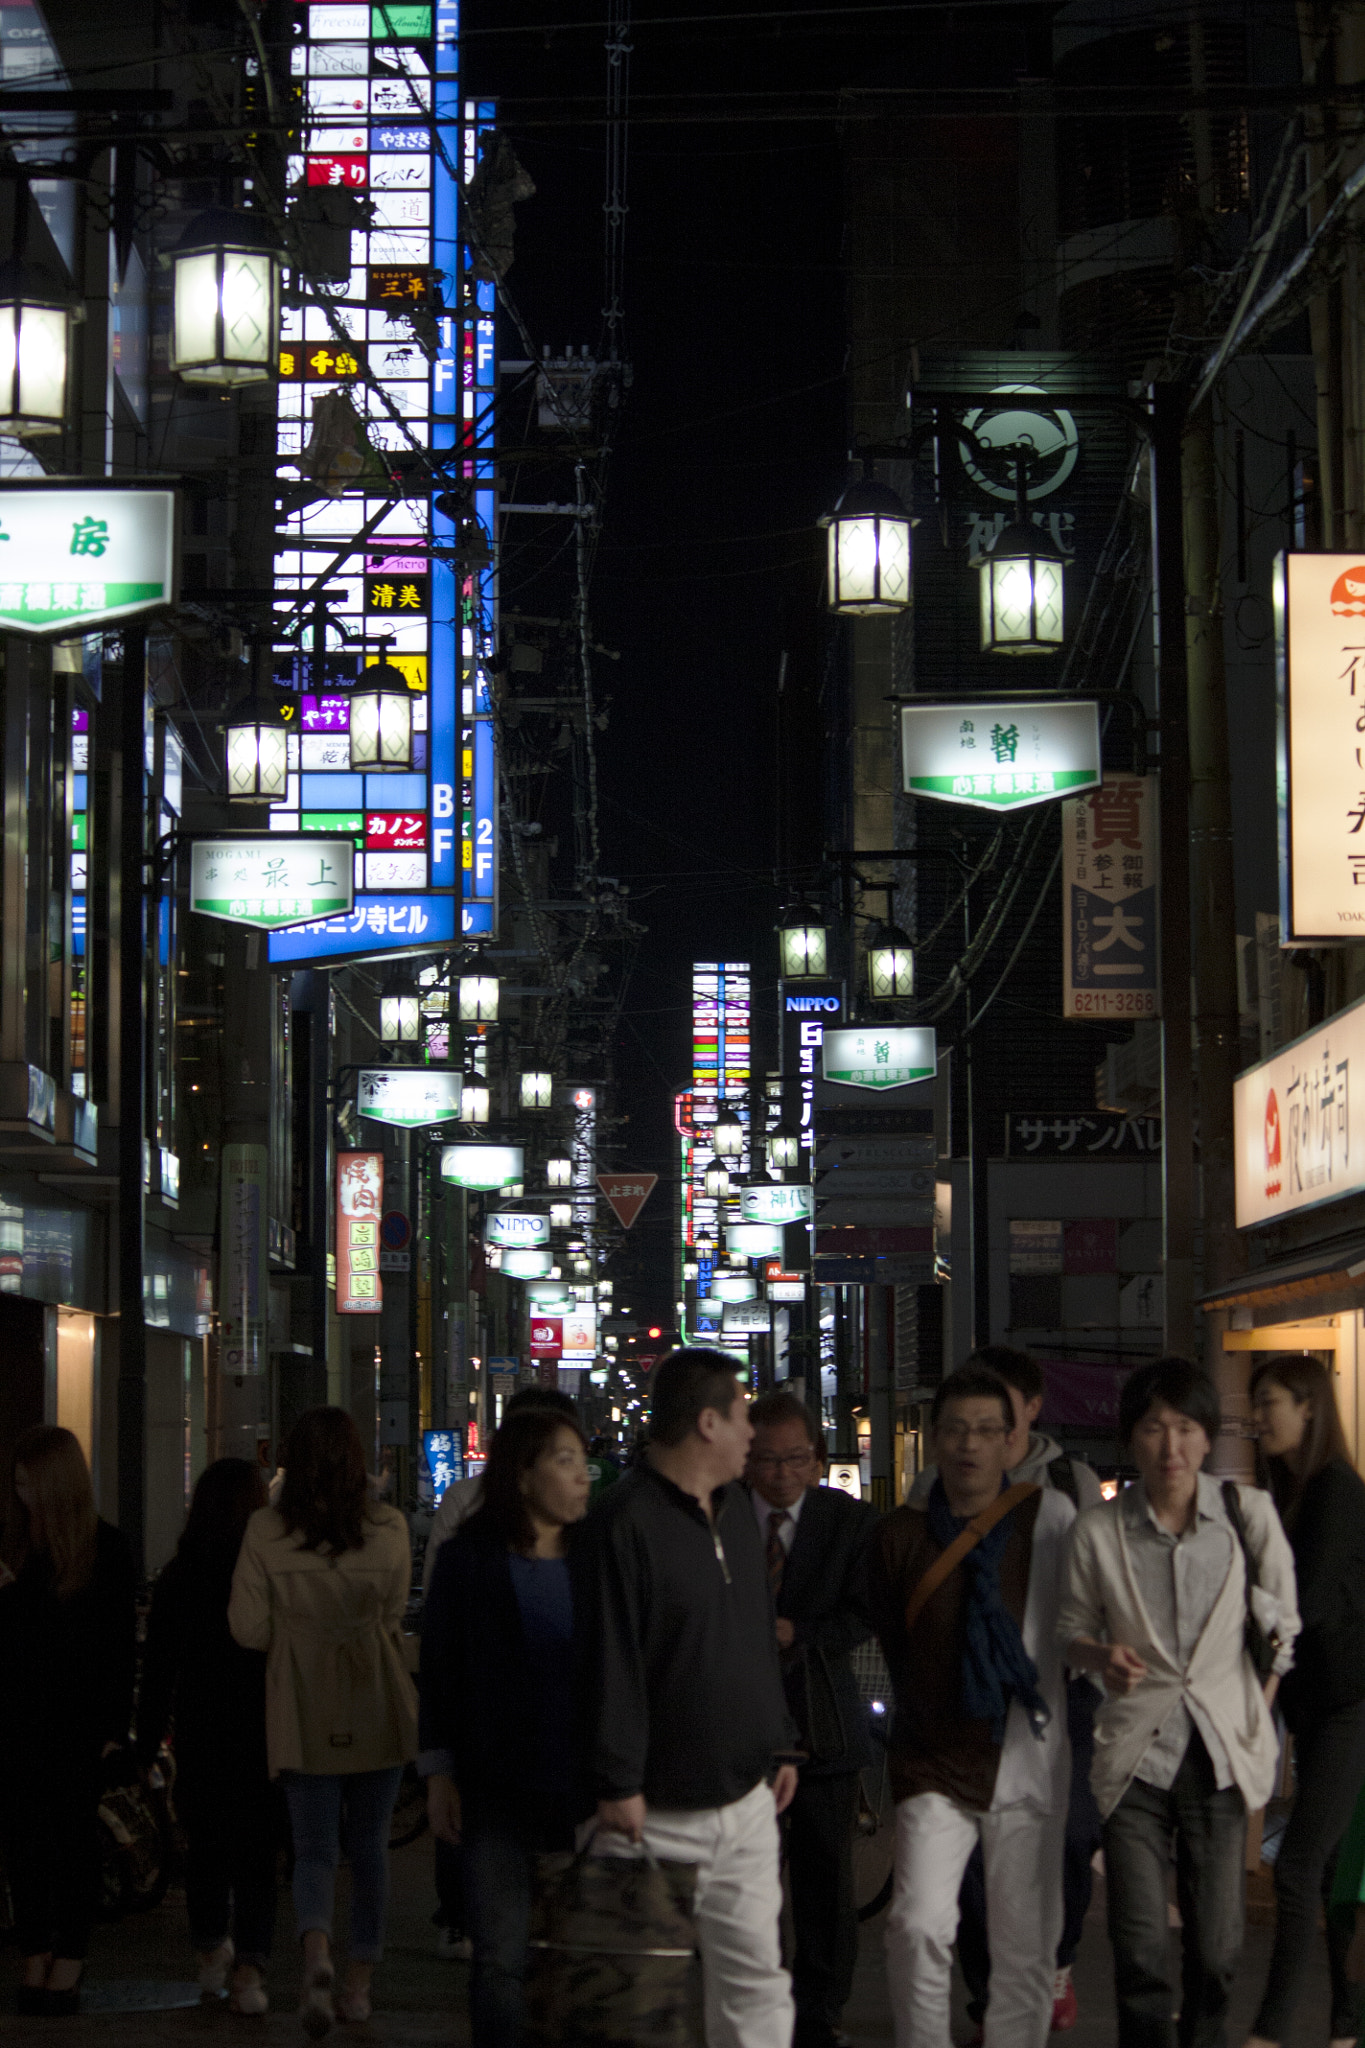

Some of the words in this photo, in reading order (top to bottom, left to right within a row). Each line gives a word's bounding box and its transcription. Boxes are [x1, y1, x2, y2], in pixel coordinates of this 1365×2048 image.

[380, 131, 430, 148] やまざき
[329, 164, 366, 185] まり
[400, 197, 426, 222] 道
[380, 278, 426, 300] 三平
[477, 320, 495, 369] 4F
[371, 583, 423, 609] 清美
[989, 723, 1021, 764] 暫
[367, 817, 424, 835] カノン
[433, 782, 455, 863] BF
[1088, 777, 1144, 851] 質
[477, 818, 493, 880] 2F
[1075, 796, 1087, 880] 心斎橋二丁目
[205, 850, 263, 860] MOGAMI
[260, 857, 339, 889] 最上
[785, 997, 840, 1012] NIPPO
[608, 1184, 646, 1198] 止まれ
[493, 1217, 544, 1232] NIPPO
